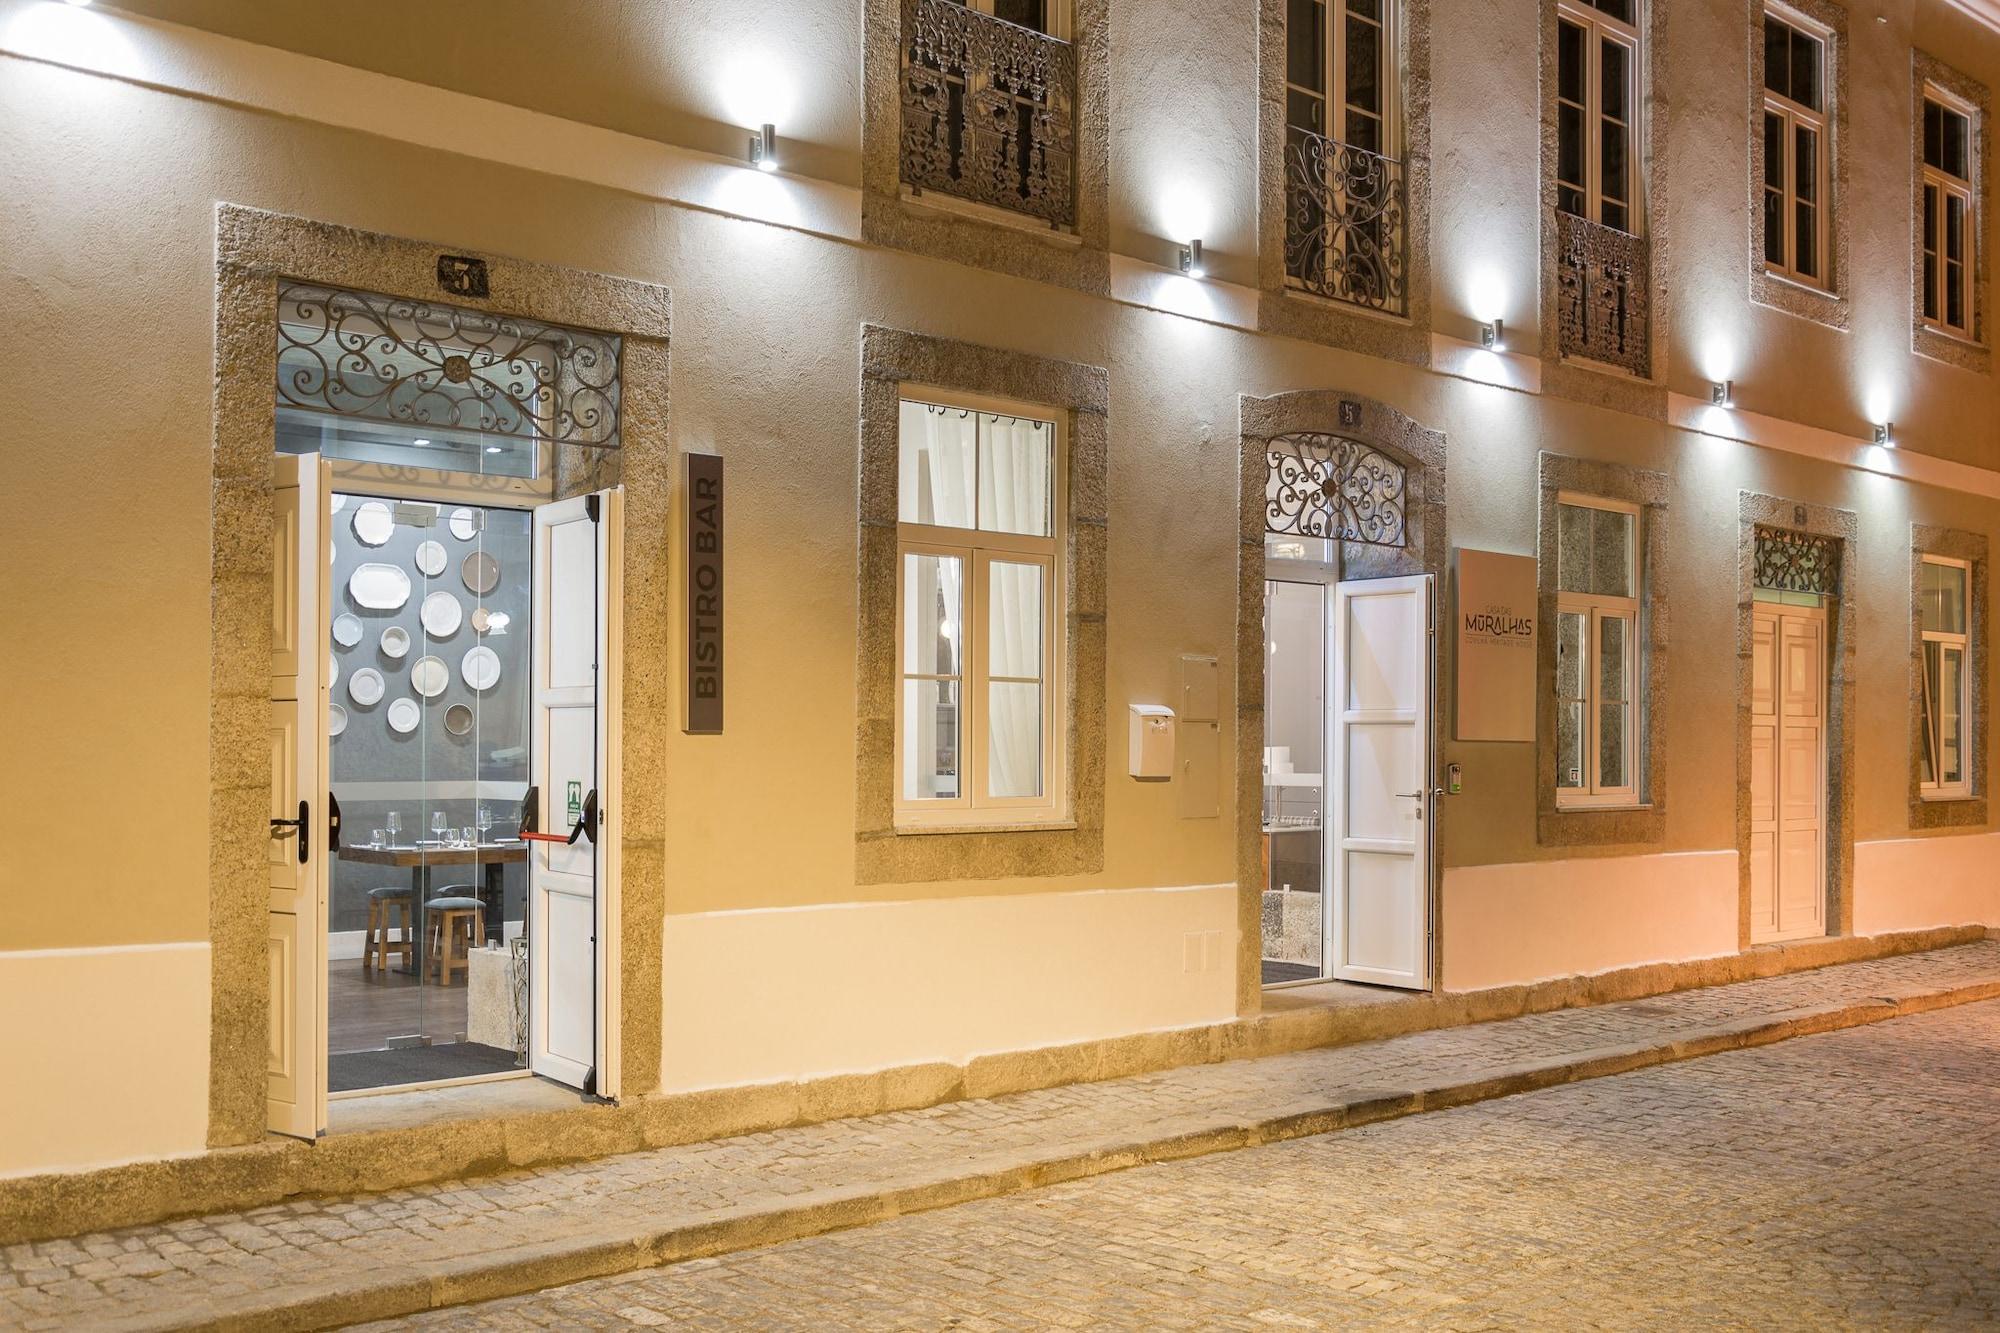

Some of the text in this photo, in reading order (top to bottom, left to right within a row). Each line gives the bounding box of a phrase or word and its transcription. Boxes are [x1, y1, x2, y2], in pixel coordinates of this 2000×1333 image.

[1344, 403, 1353, 423] 5
[695, 476, 719, 699] BISTRO BAR
